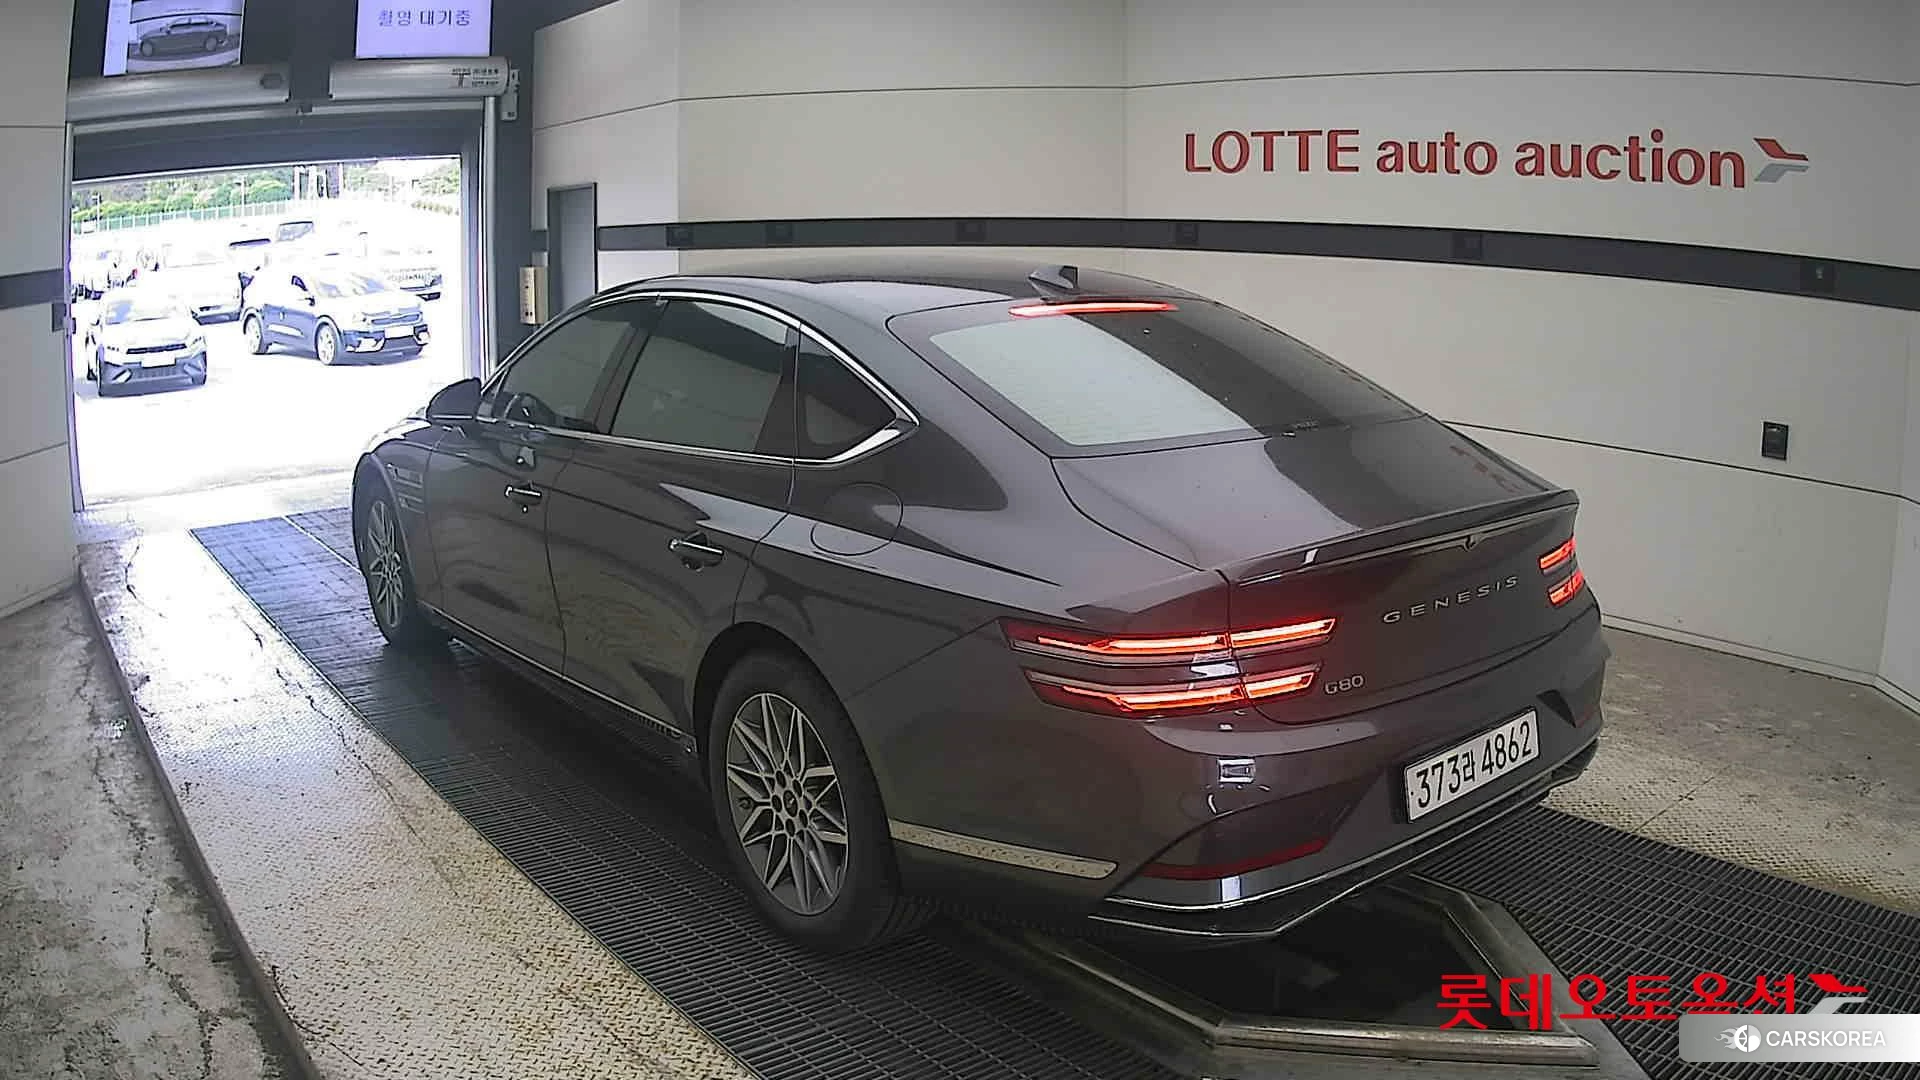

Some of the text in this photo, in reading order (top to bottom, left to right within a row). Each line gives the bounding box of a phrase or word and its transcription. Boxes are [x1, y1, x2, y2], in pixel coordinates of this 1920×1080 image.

[420, 9, 471, 26] 대기중
[1184, 129, 1746, 188] LOTTE auto auction
[1383, 576, 1518, 624] GENESIS
[1324, 674, 1365, 696] G80
[1415, 720, 1532, 808] 373라 4862
